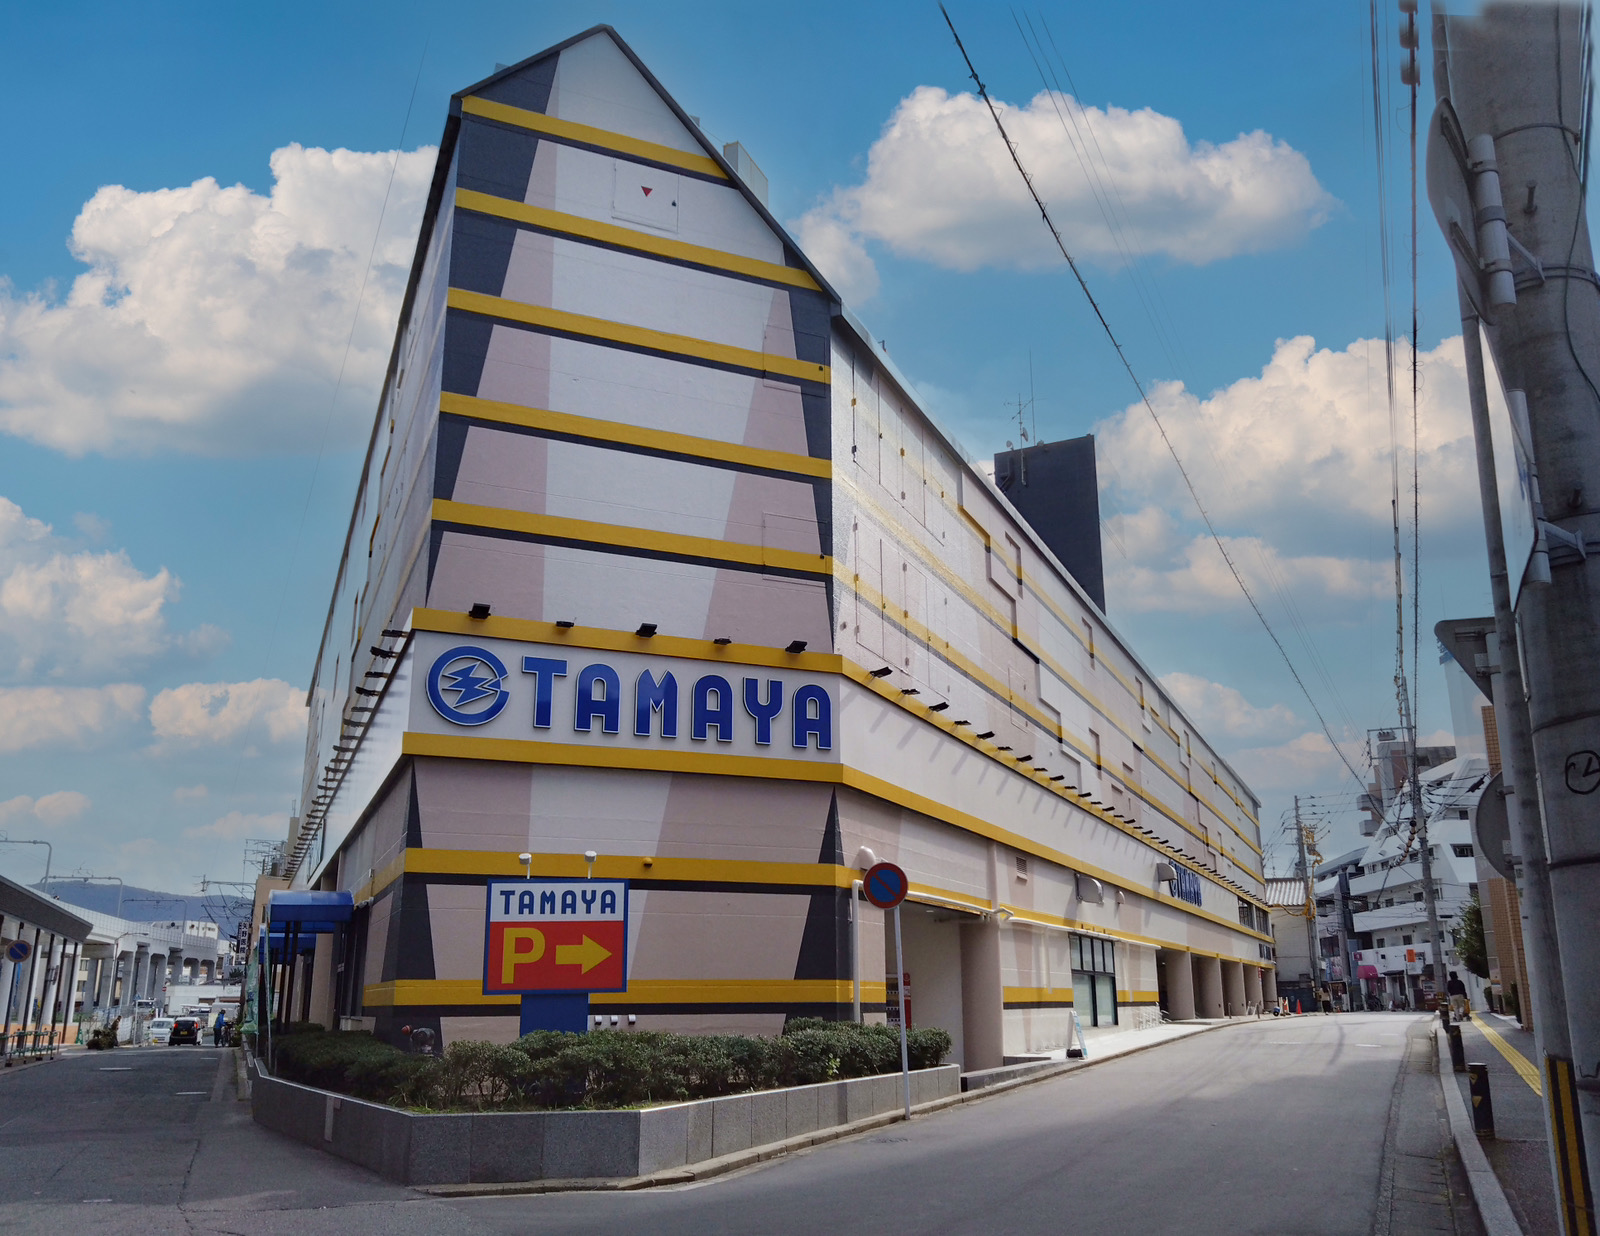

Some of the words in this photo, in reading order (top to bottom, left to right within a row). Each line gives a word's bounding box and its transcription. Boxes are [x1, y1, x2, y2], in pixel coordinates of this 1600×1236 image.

[521, 655, 832, 751] TAMAYA
[499, 889, 617, 915] TAMAYA
[501, 927, 546, 984] P
